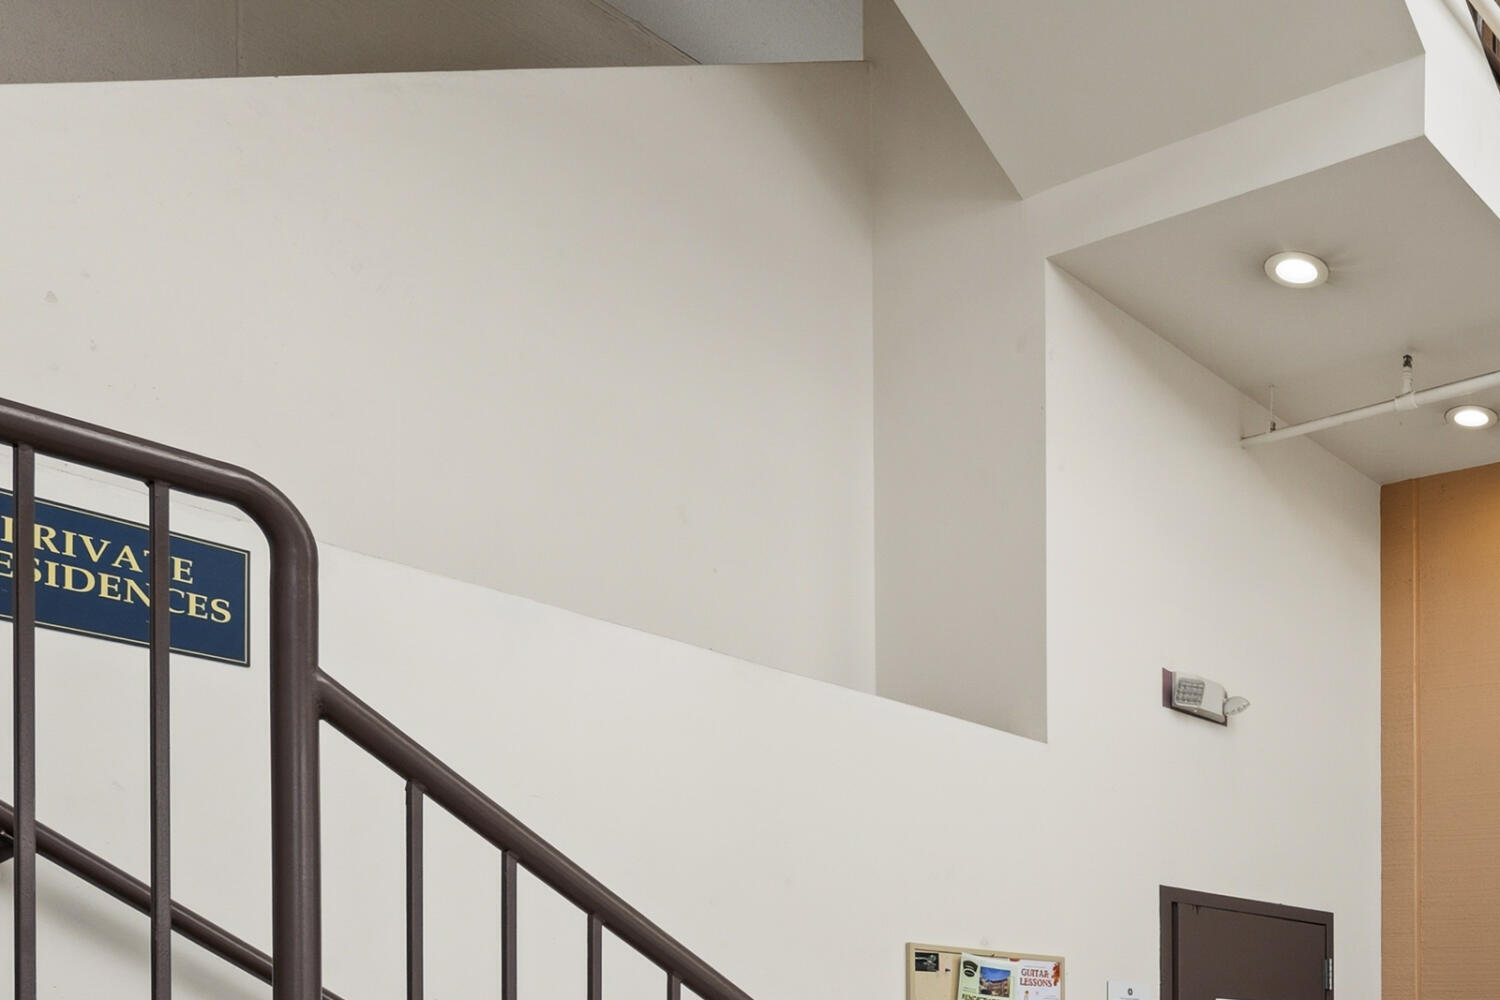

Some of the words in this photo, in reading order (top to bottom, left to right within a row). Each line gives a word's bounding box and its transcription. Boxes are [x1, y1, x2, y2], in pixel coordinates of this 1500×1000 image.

[0, 515, 194, 584] RIVAE
[1021, 968, 1049, 979] GUITAR
[1020, 978, 1053, 988] LESSONS
